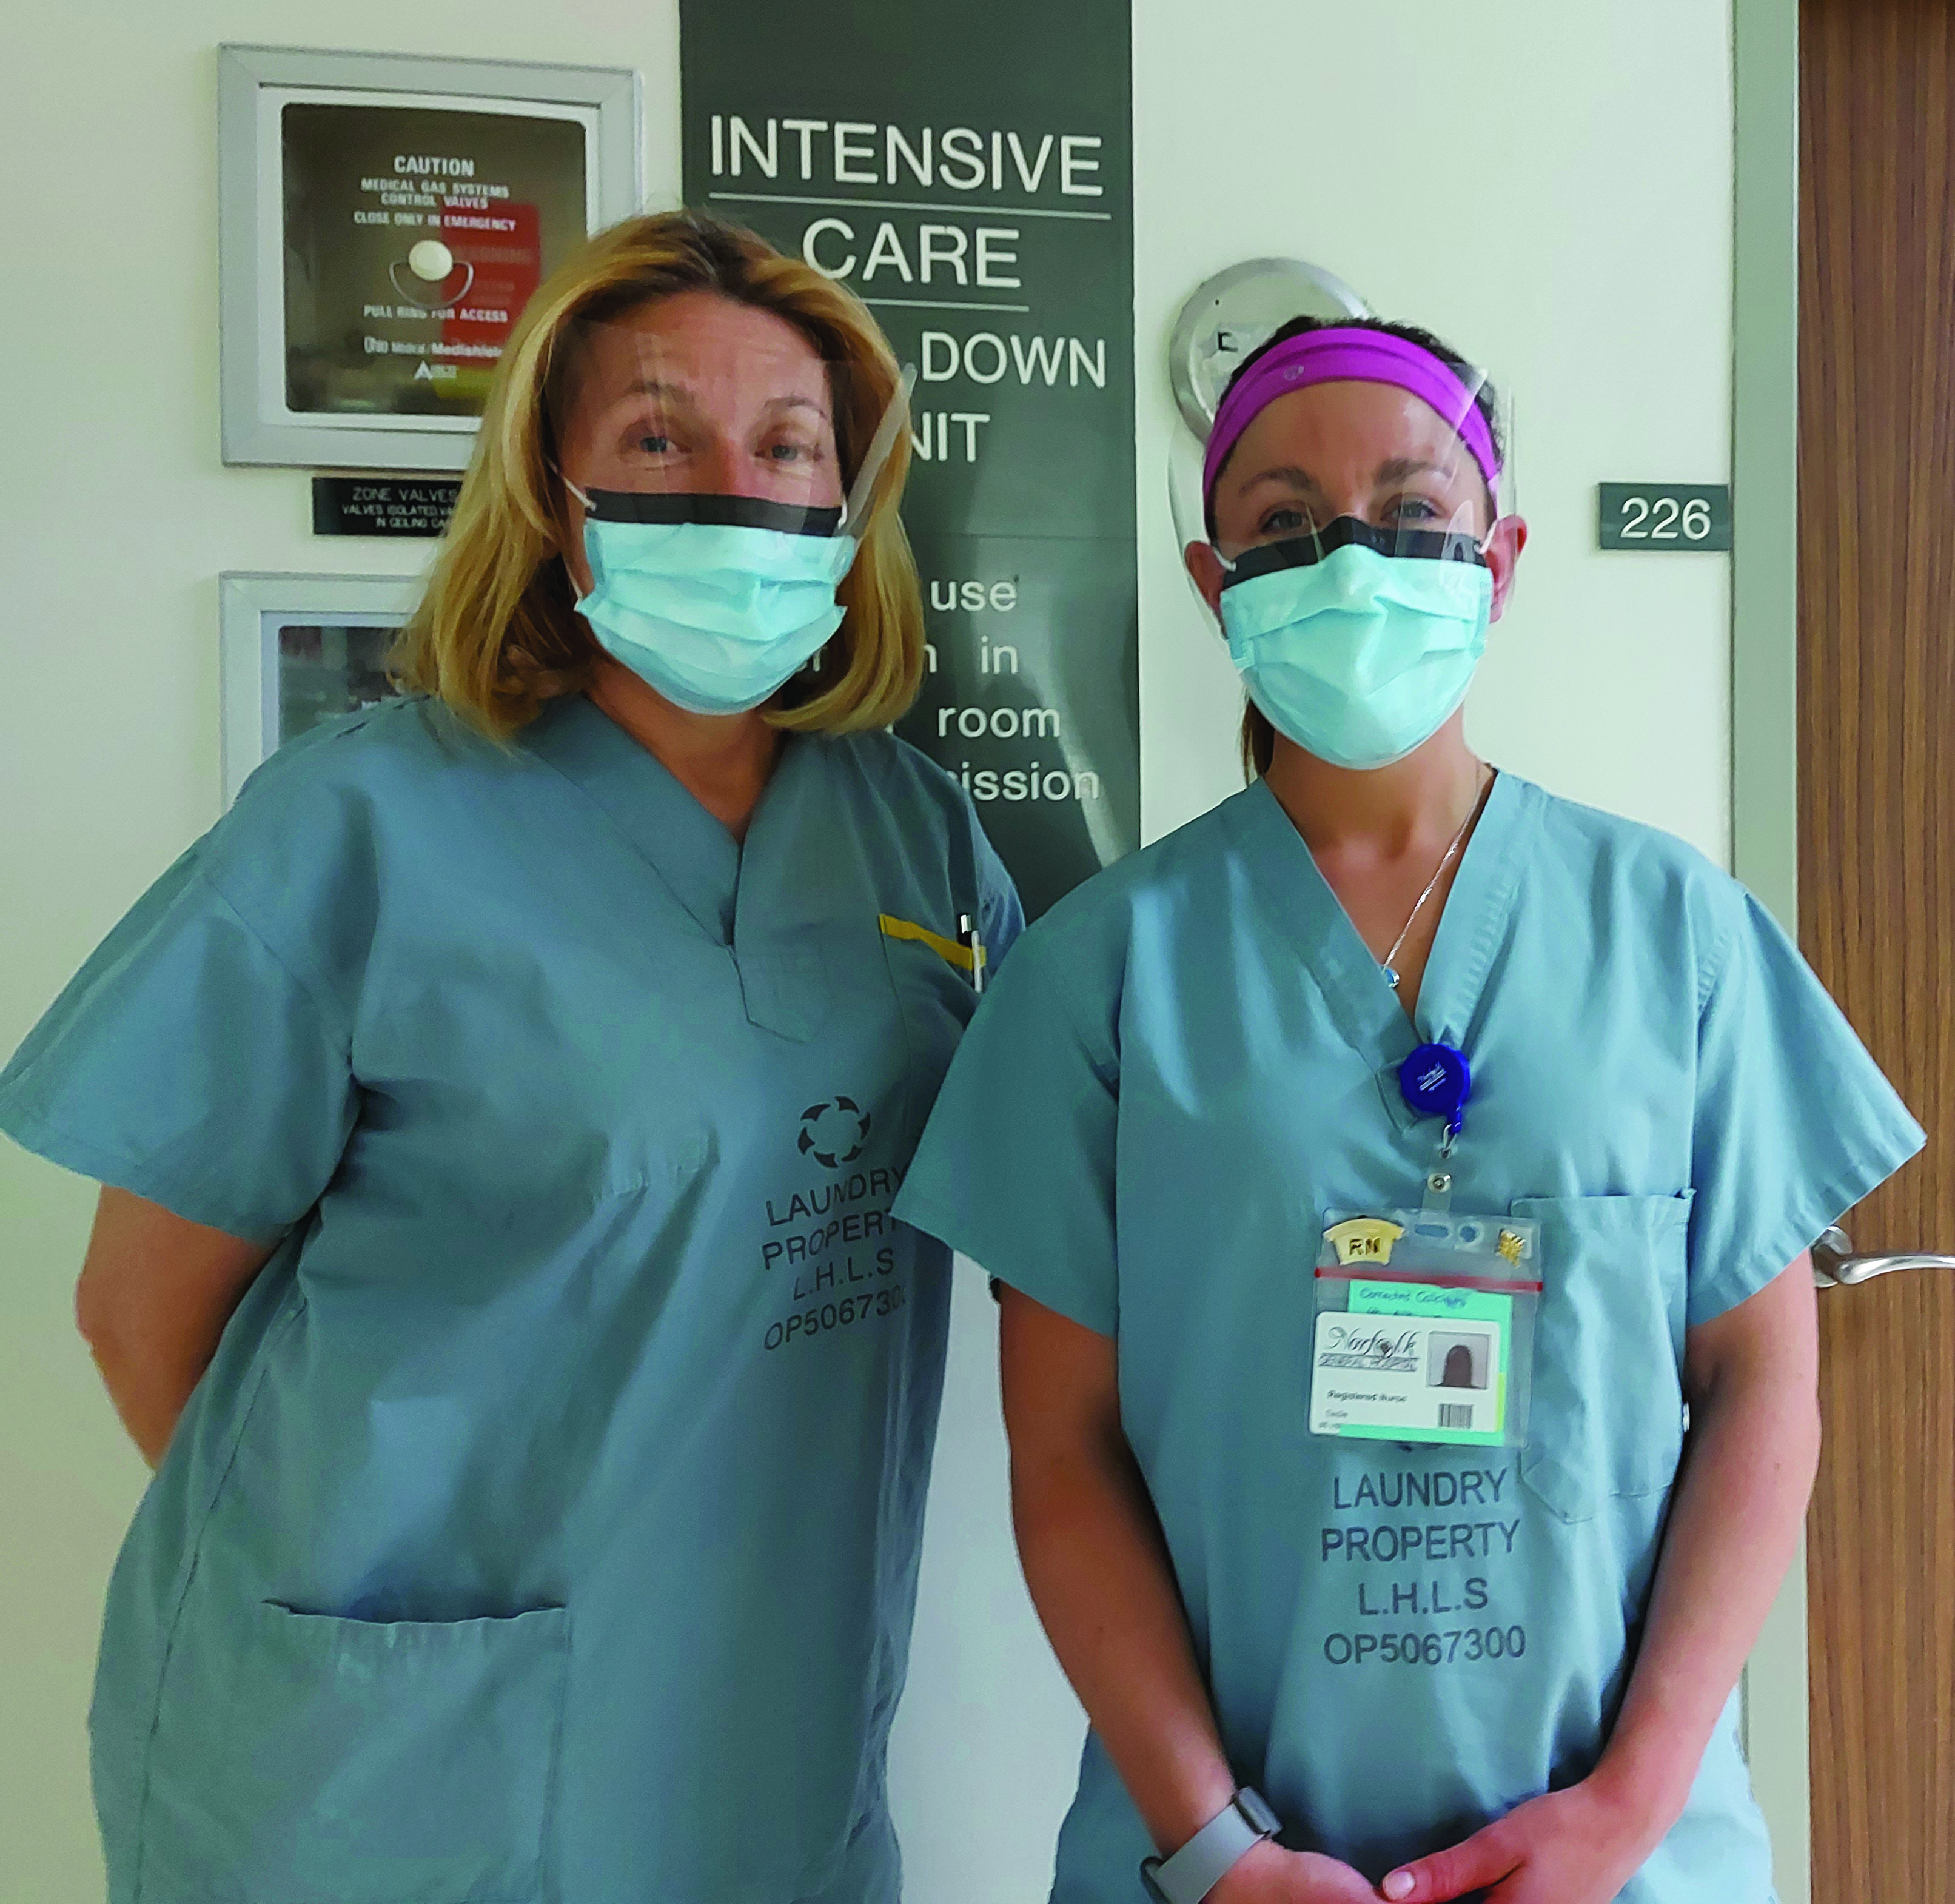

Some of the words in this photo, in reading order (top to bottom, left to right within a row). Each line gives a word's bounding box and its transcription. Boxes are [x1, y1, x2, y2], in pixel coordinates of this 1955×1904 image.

[394, 155, 475, 178] CAUTION
[711, 115, 1104, 197] INTENSIVE
[443, 195, 488, 209] VALVES
[803, 218, 1022, 289] CARE
[459, 307, 508, 323] ACCESS
[921, 330, 1107, 389] DOWN
[910, 411, 991, 463] NIT
[352, 486, 392, 502] ZONE
[1620, 497, 1711, 540] 226
[930, 580, 1018, 612] use
[981, 635, 1019, 675] in
[937, 706, 1061, 739] room
[766, 1164, 909, 1227] LAUNDRY
[762, 1207, 896, 1270] PROPERT
[1349, 1237, 1380, 1256] RN
[793, 1247, 894, 1301] L.H.L.S
[1324, 1326, 1423, 1359] Norfolk
[1334, 1467, 1507, 1509] LAUNDRY
[1321, 1518, 1520, 1562] PROPERTY
[1358, 1577, 1489, 1615] L.H.L.S
[1324, 1624, 1526, 1665] OP5067300
